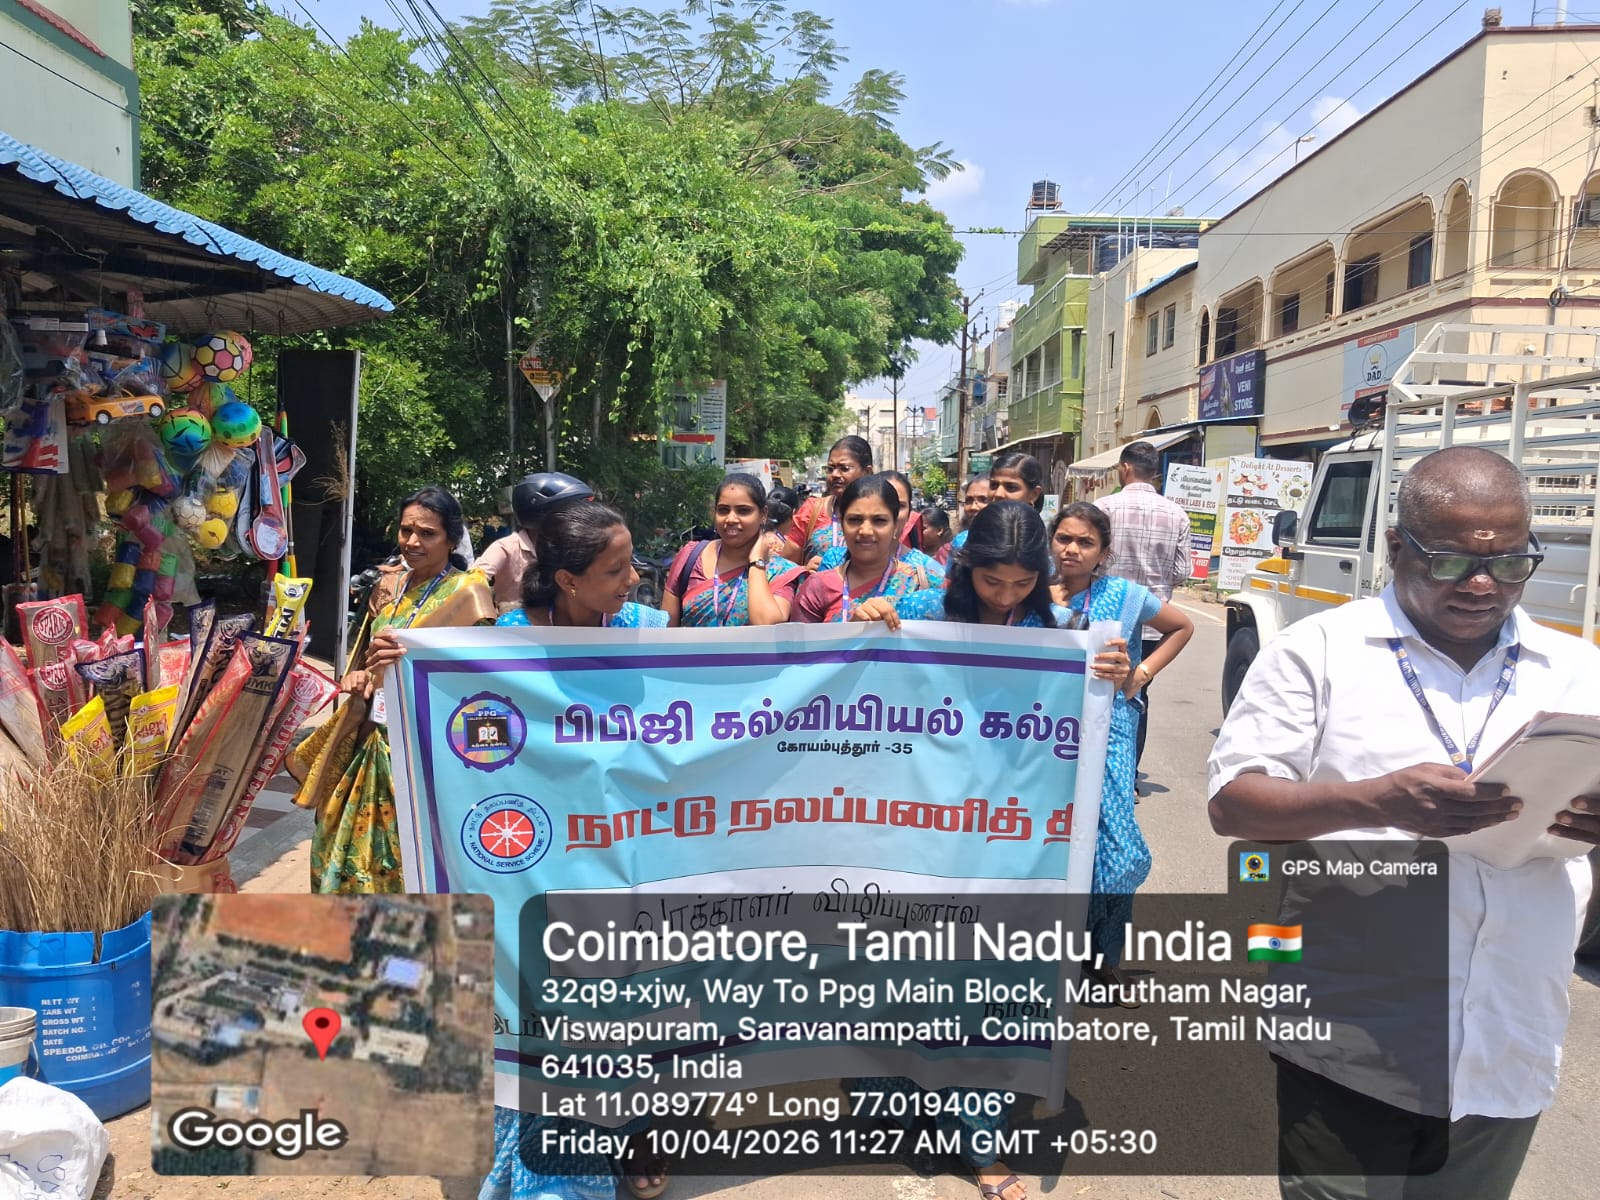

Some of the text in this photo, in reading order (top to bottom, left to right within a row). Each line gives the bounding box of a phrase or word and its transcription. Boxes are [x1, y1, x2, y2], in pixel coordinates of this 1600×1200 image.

[1367, 371, 1382, 381] DAD
[1237, 380, 1251, 393] VENI
[1234, 397, 1254, 411] STORE
[1241, 461, 1265, 471] Delight
[1275, 463, 1302, 473] Desserts
[554, 700, 693, 745] பிபிஜி
[711, 693, 963, 740] கல்வியியல்
[777, 739, 912, 757] கோயம்புத்தூர் -35
[566, 796, 716, 853] நாட்டு
[728, 787, 1032, 844] நலப்பணித்
[470, 838, 544, 868] NATIONAL SERVICE SCHEME
[42, 1018, 69, 1026] GROSS
[42, 1028, 69, 1036] BATCH
[43, 1046, 88, 1056] SPEEDOL
